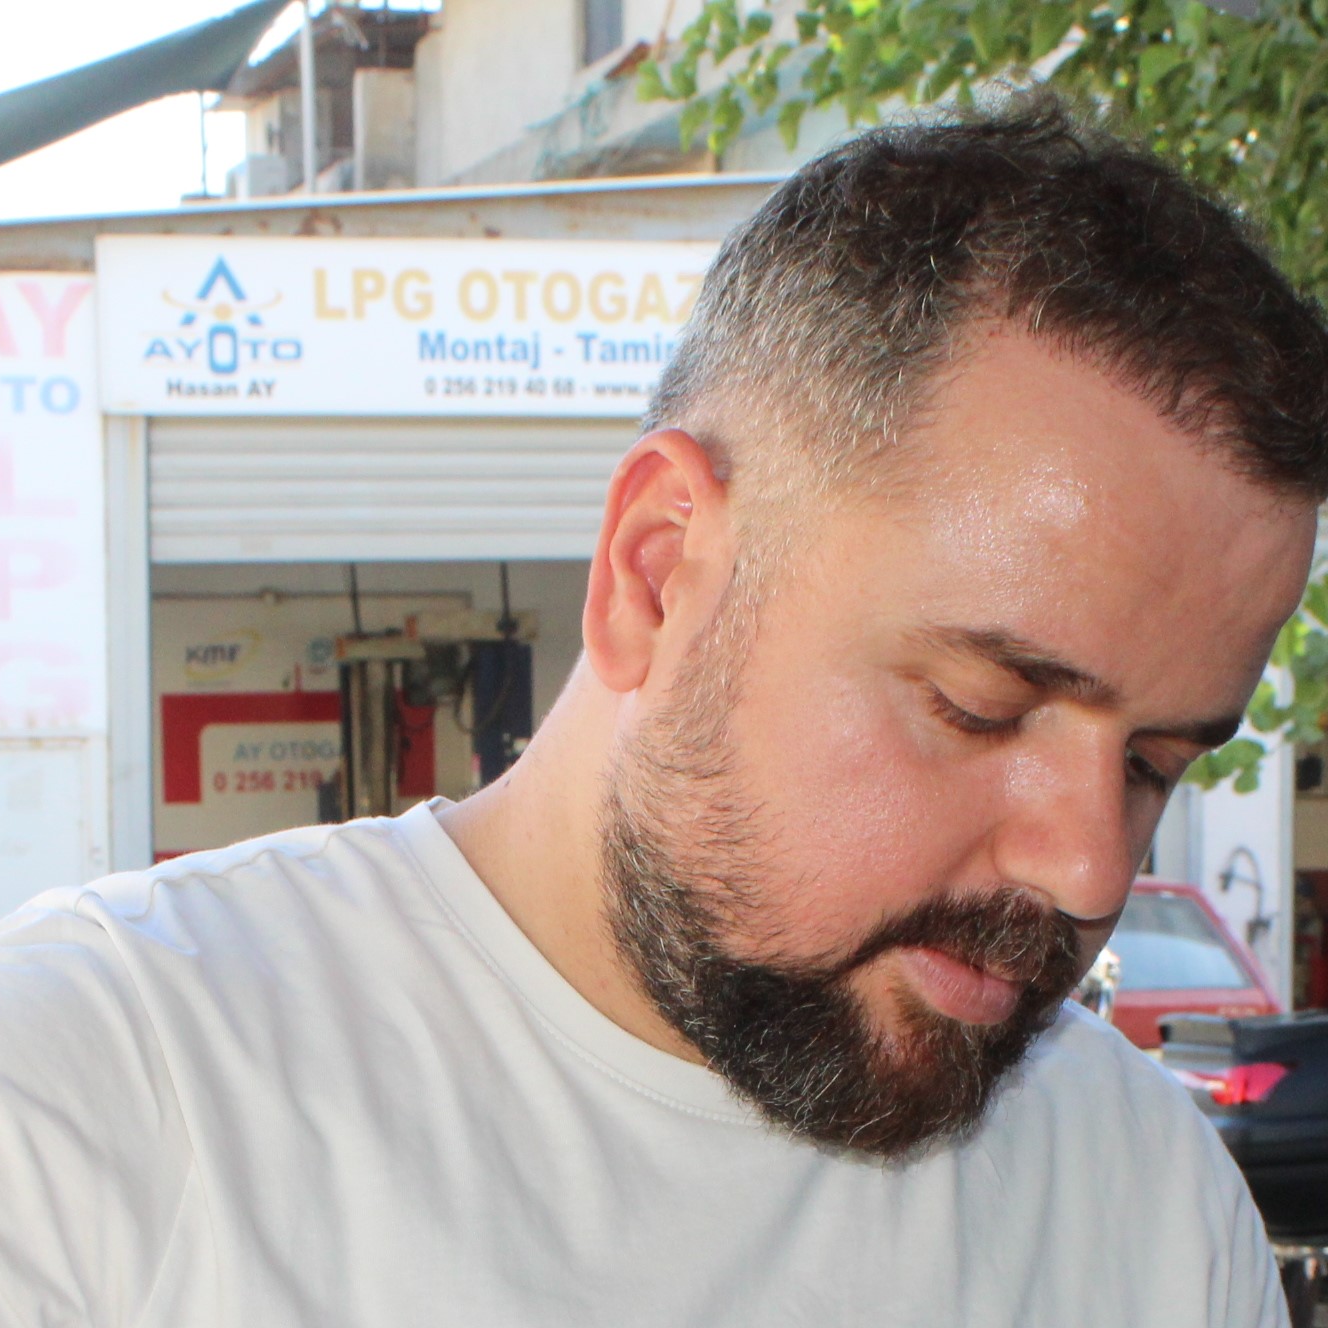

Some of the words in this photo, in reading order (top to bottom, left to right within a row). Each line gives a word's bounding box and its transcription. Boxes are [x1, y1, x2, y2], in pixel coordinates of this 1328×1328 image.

[312, 268, 435, 322] LPG
[458, 270, 706, 324] OTOGAZ
[418, 331, 541, 369] Montaj
[166, 379, 239, 398] Hasan
[247, 379, 276, 398] AY
